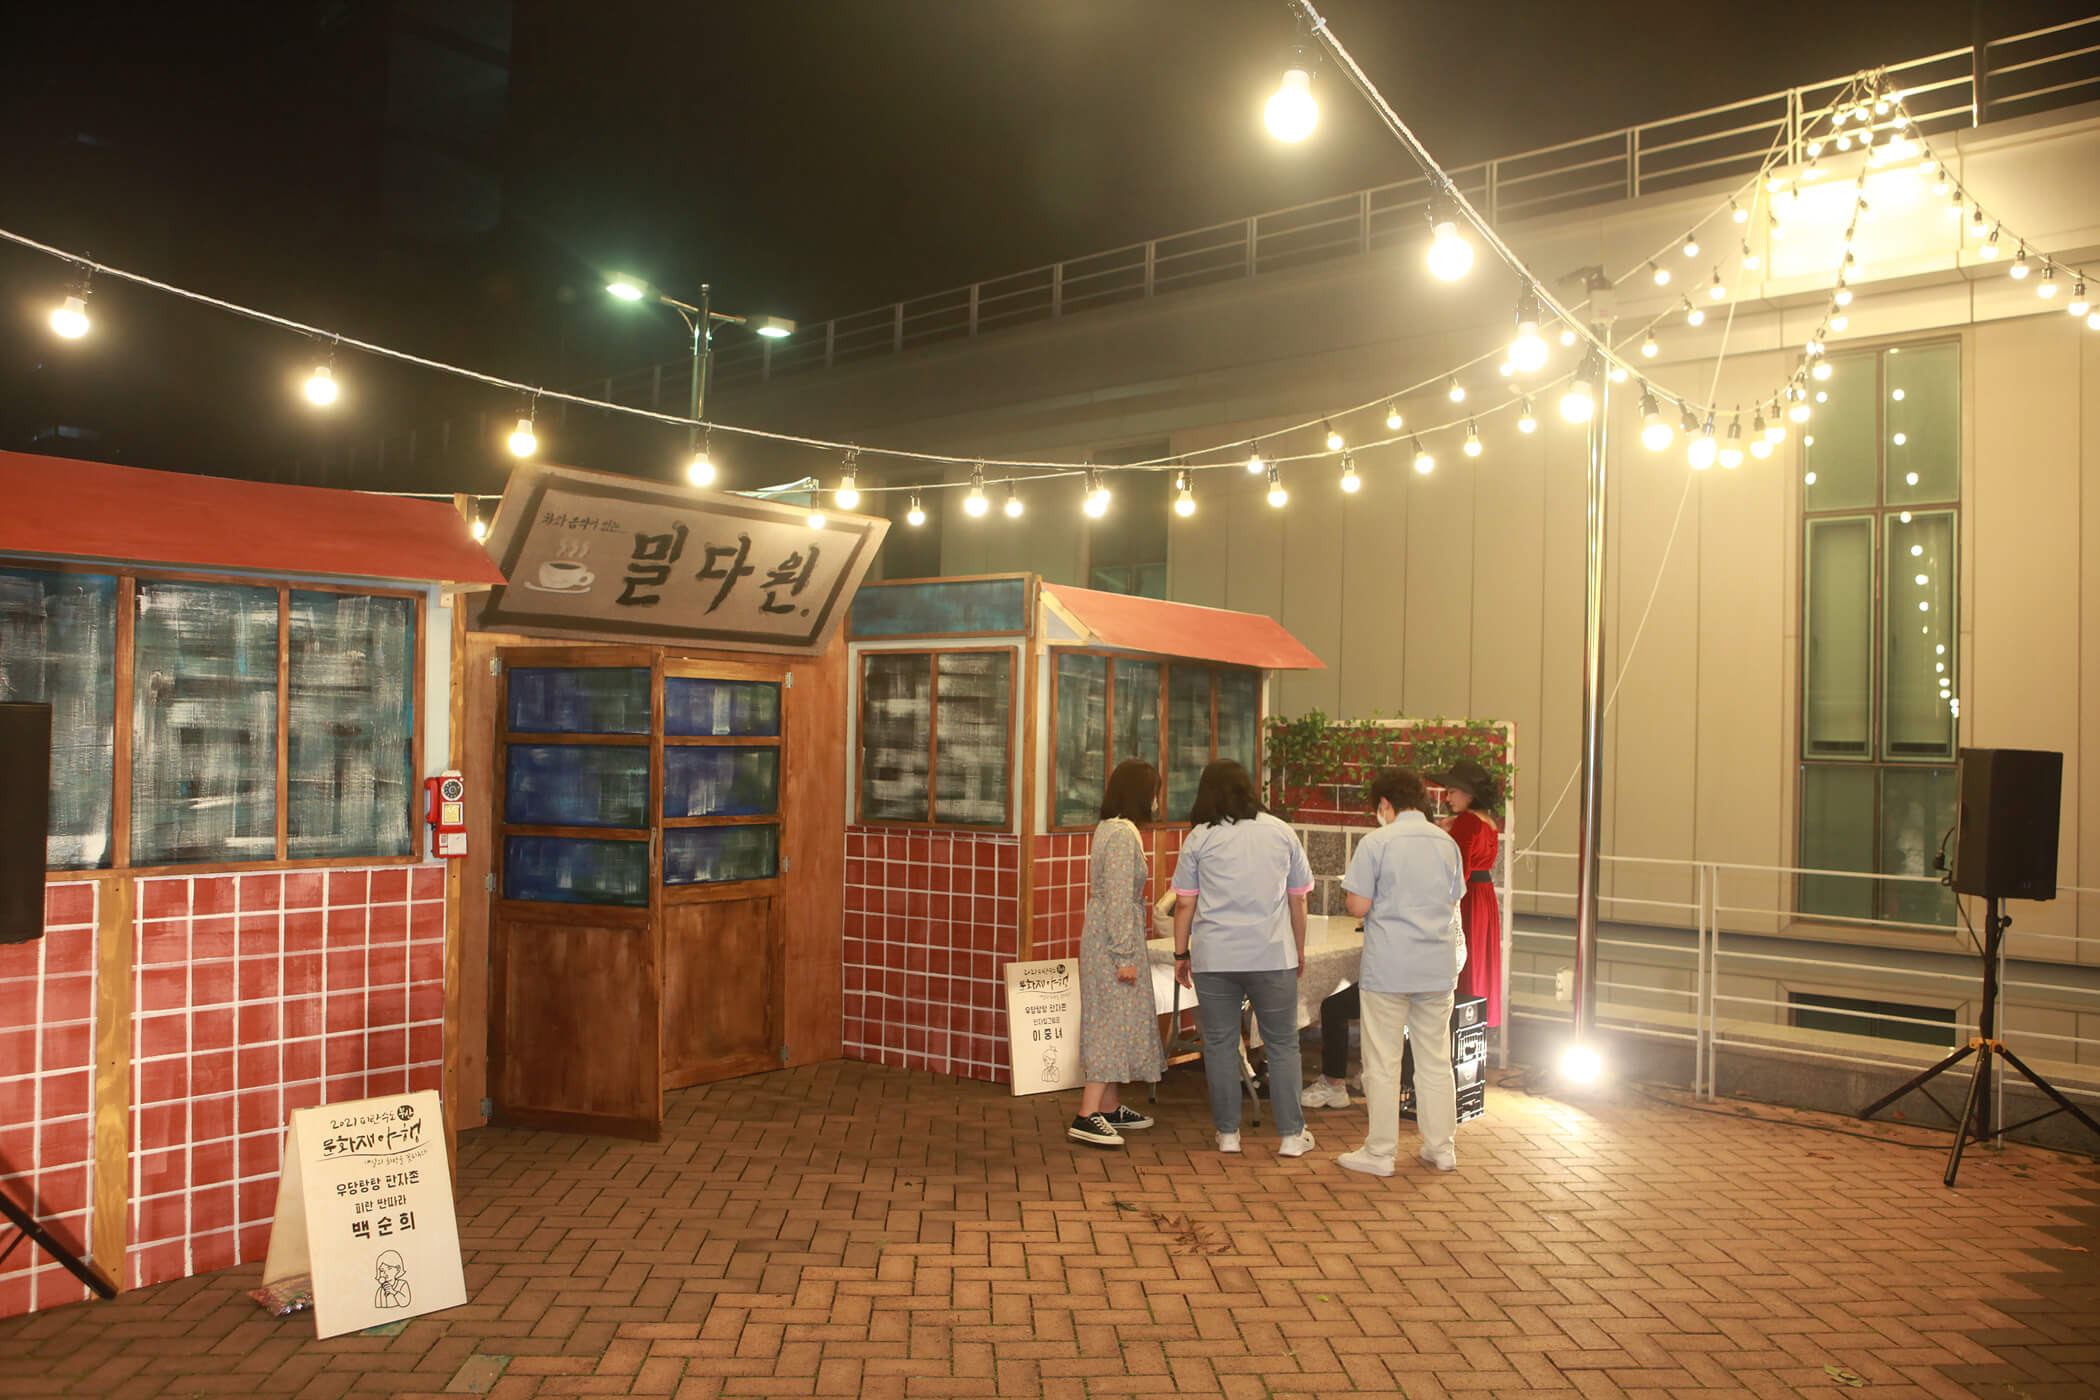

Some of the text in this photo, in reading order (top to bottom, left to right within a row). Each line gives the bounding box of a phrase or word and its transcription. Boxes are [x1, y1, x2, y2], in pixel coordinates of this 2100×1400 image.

[330, 1117, 357, 1129] 2021
[336, 1177, 381, 1197] 우당탕탕
[354, 1200, 373, 1214] 피란
